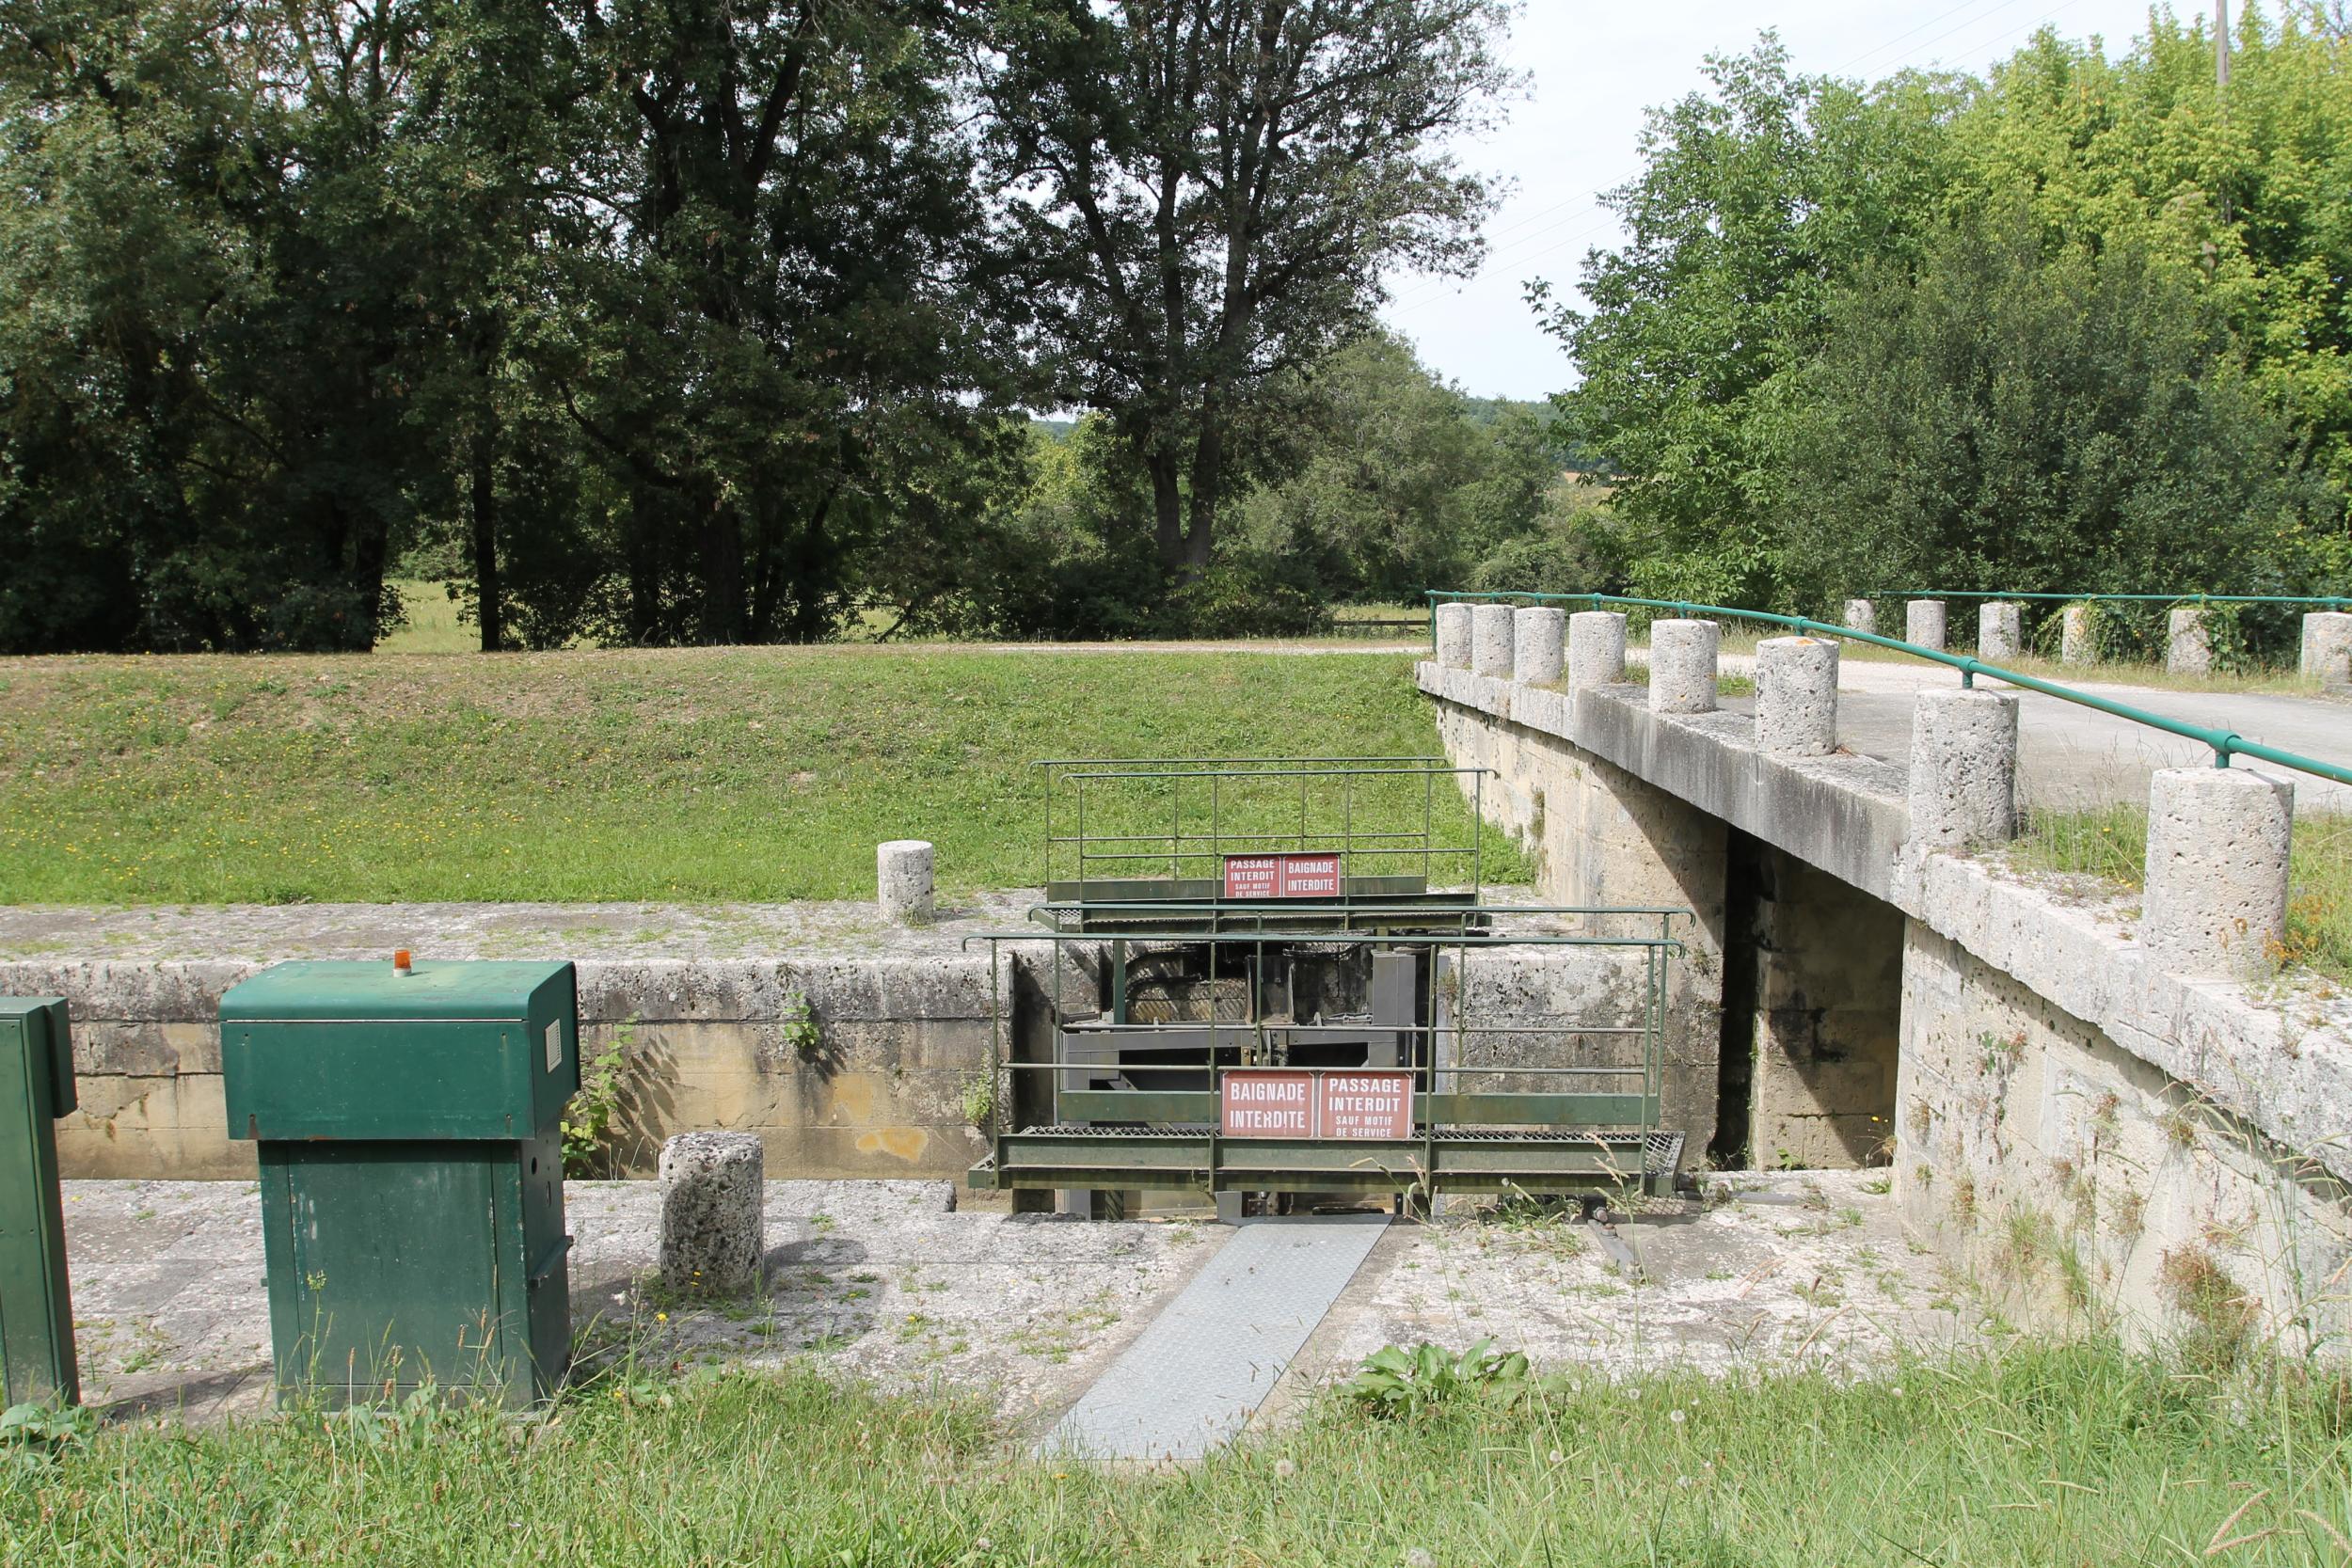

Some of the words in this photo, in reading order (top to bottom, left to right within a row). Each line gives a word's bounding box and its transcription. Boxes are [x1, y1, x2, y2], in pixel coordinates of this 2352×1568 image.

[1231, 860, 1275, 869] PASSAGE
[1288, 862, 1334, 874] BAIGNADE
[1231, 871, 1275, 881] INTERDIT
[1288, 879, 1334, 891] INTERDITE
[1329, 1078, 1401, 1093] PASSAGE
[1231, 1083, 1306, 1101] BAIGNADE
[1328, 1097, 1401, 1112] INTERDIT
[1230, 1110, 1306, 1129] INTERDITE
[1335, 1116, 1359, 1126] SAUF
[1364, 1116, 1393, 1126] MOTIF
[1336, 1128, 1349, 1137] DE
[1352, 1128, 1391, 1137] SERVICE
